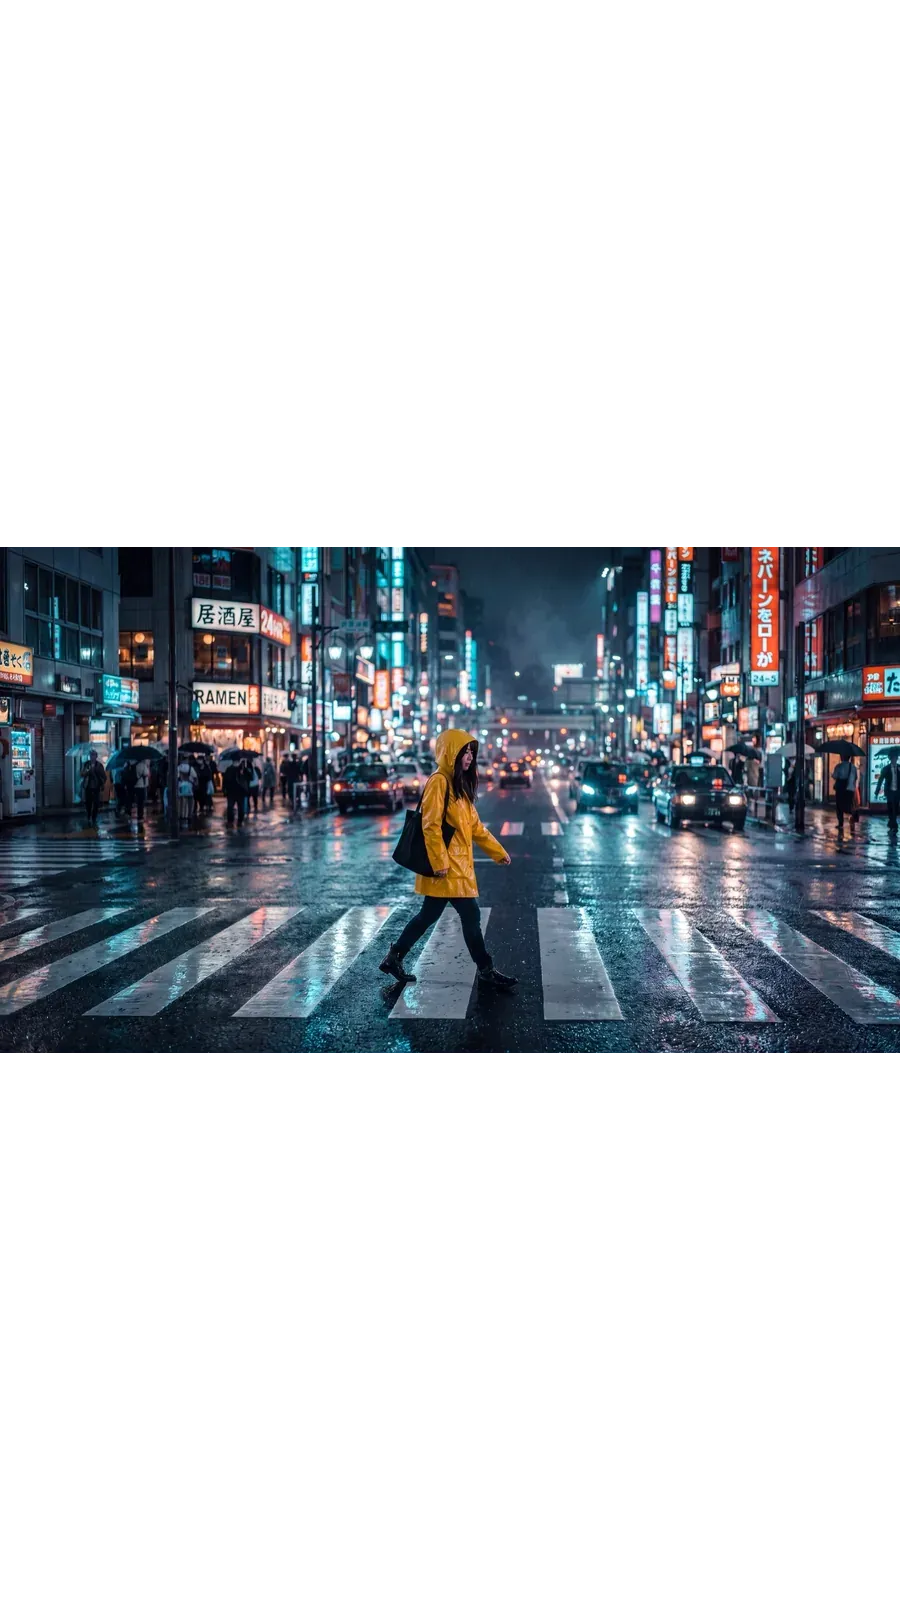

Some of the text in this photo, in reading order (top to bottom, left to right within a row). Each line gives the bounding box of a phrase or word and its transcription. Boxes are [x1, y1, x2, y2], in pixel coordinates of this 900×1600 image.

[196, 603, 256, 628] 居酒屋
[752, 674, 777, 683] 24-5
[194, 689, 247, 706] RAMEN
